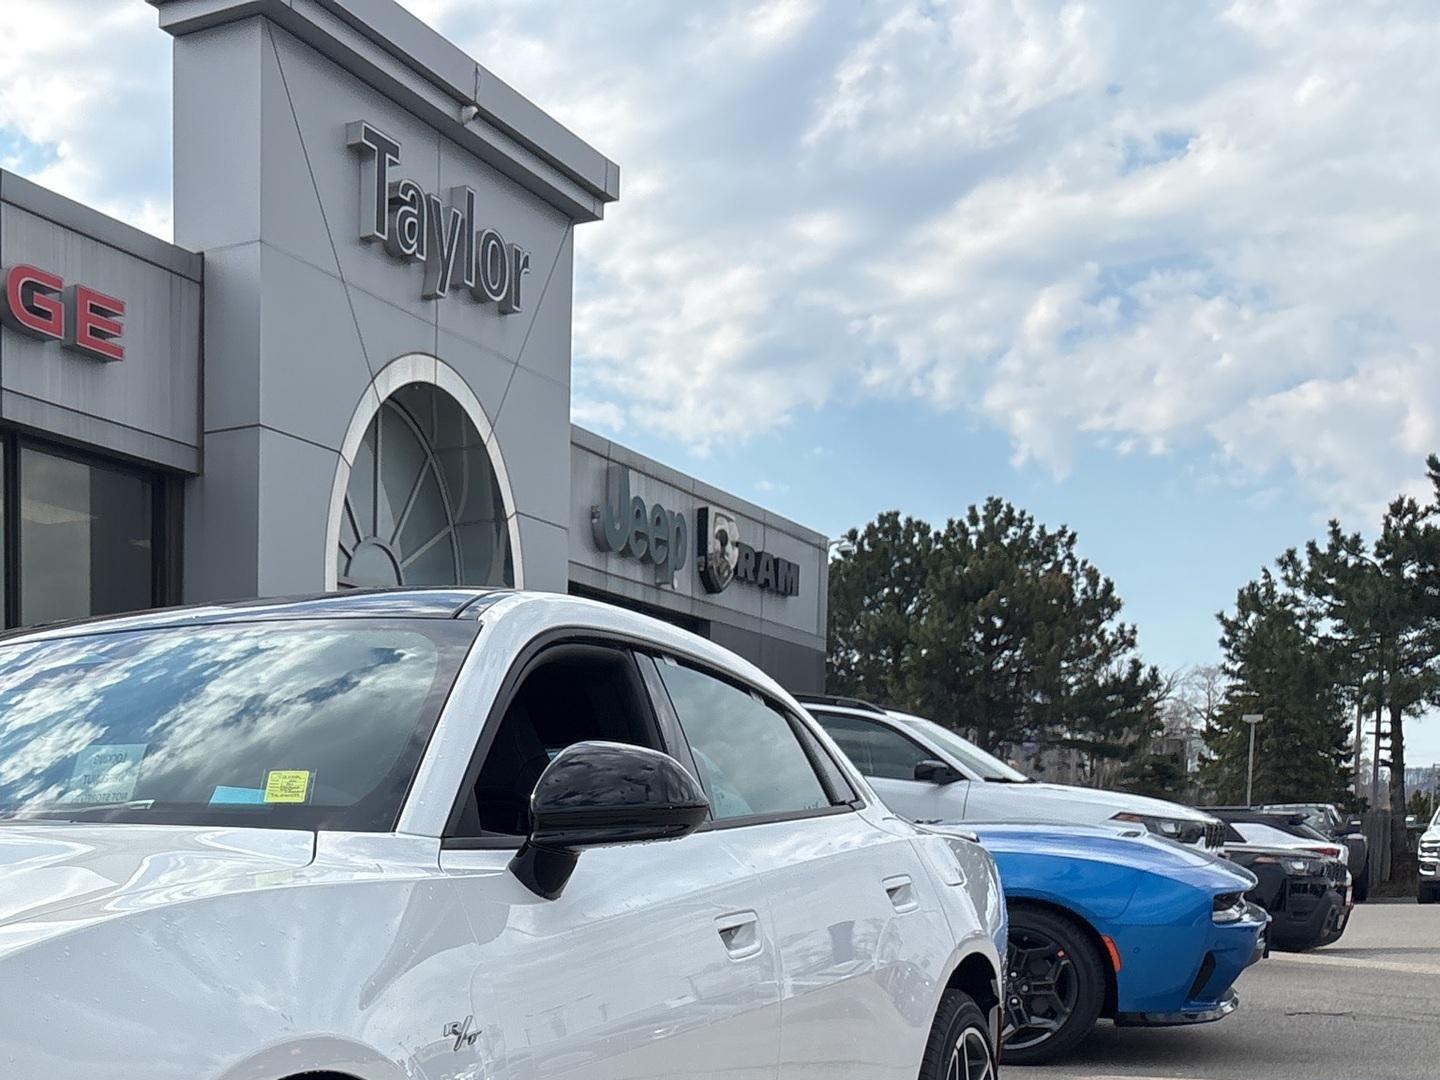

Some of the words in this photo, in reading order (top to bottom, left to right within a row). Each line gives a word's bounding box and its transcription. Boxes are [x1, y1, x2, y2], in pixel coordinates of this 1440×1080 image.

[354, 120, 531, 313] Taylor
[596, 465, 689, 588] Jeep
[735, 541, 800, 596] RAM
